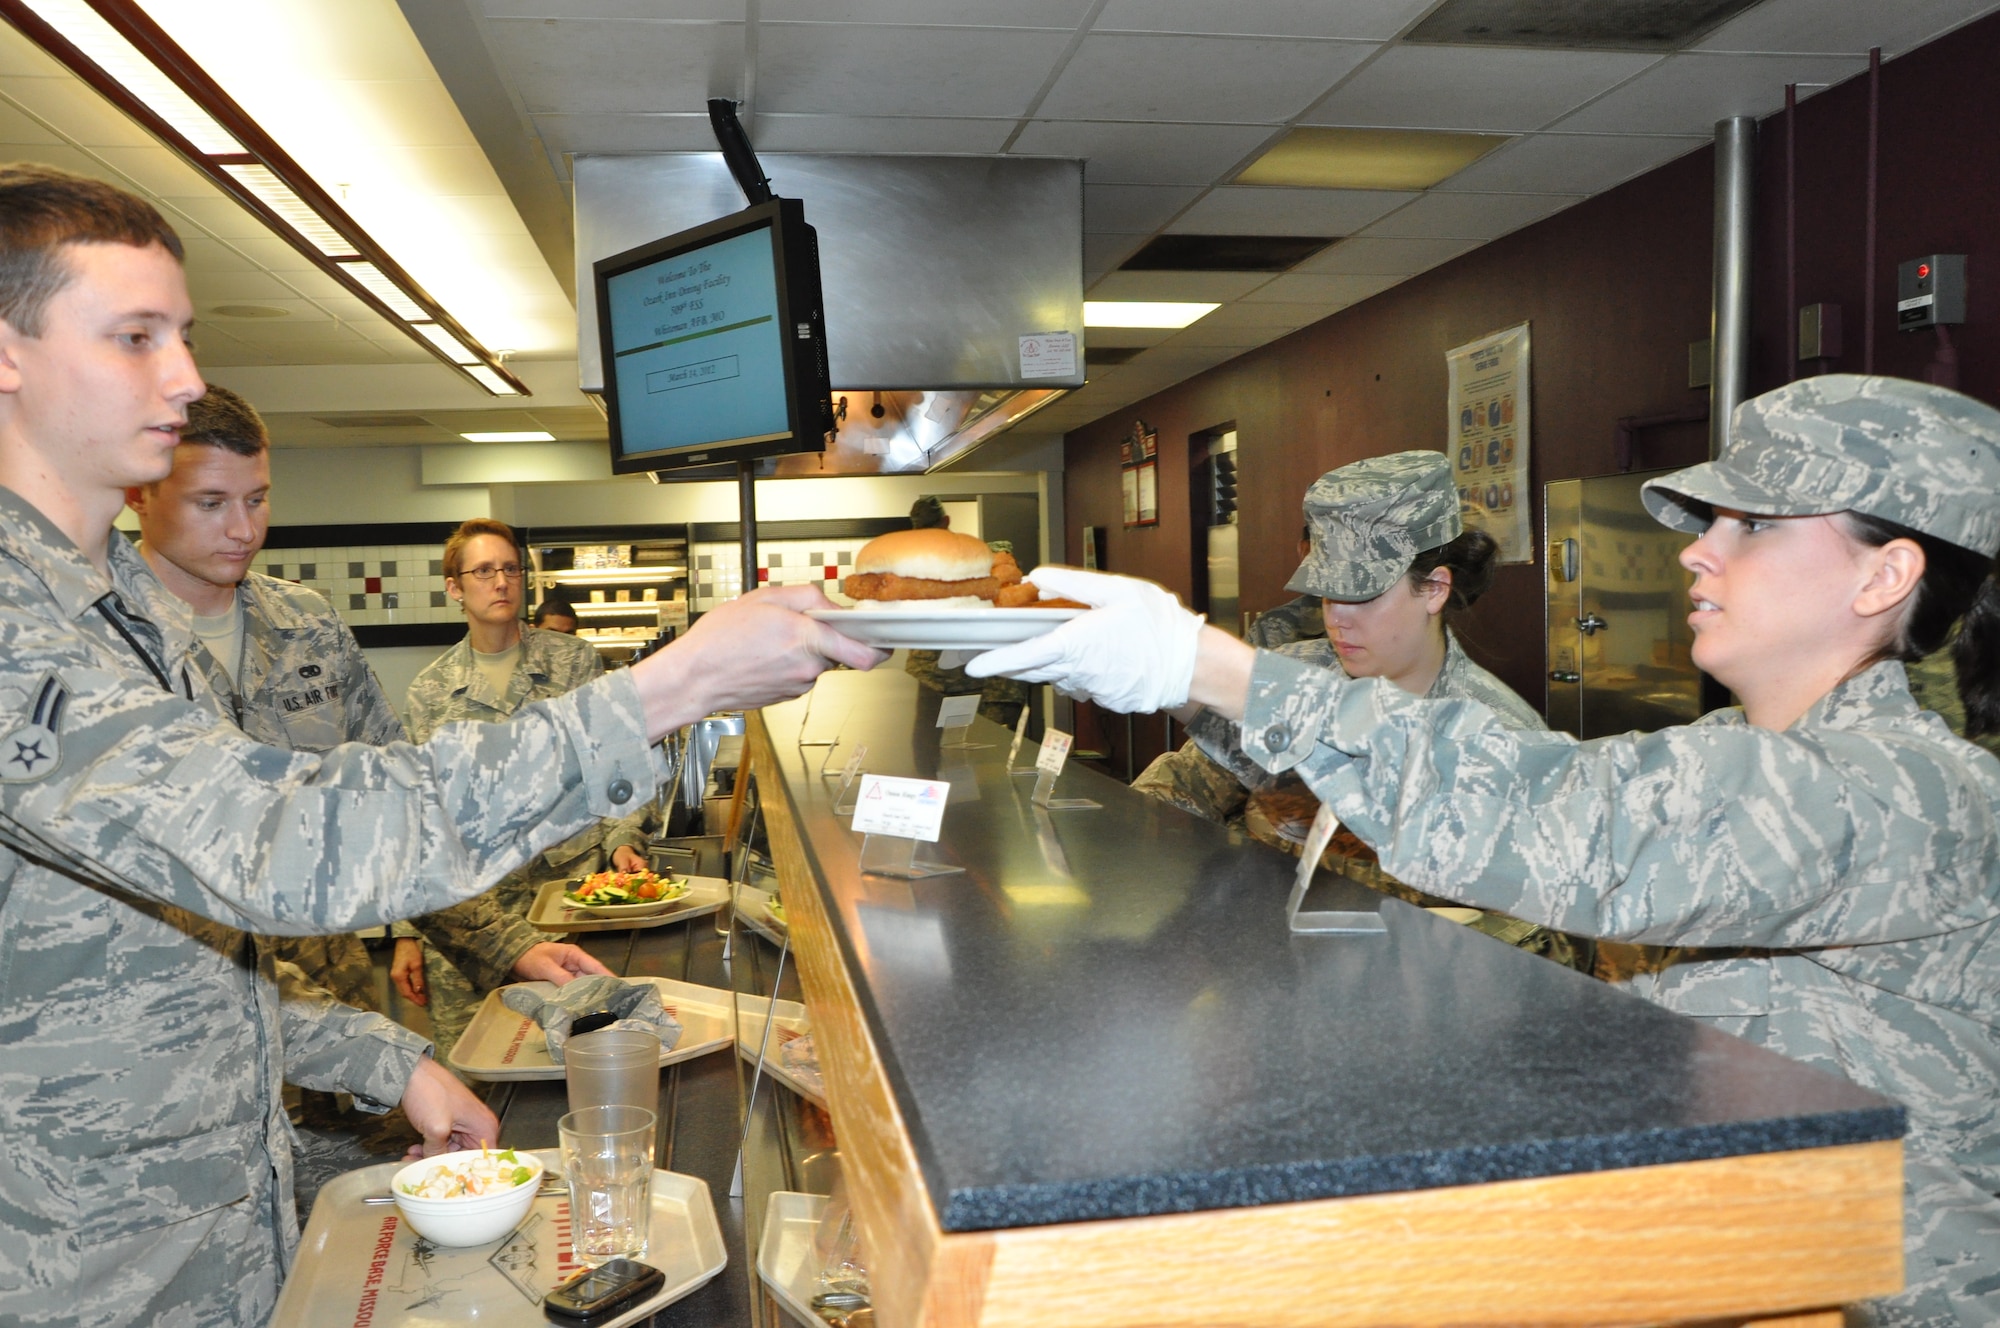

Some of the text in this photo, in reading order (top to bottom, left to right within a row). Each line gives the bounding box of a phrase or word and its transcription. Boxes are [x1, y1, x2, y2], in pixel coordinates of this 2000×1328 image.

[658, 260, 712, 285] Welcome To The
[703, 273, 731, 289] Facility
[667, 369, 687, 383] March
[700, 364, 716, 376] 2012
[282, 696, 303, 711] U.S.
[305, 689, 323, 706] AIR
[379, 1216, 398, 1232] AIR
[373, 1231, 395, 1260] FORCE
[363, 1260, 387, 1288] BASE,
